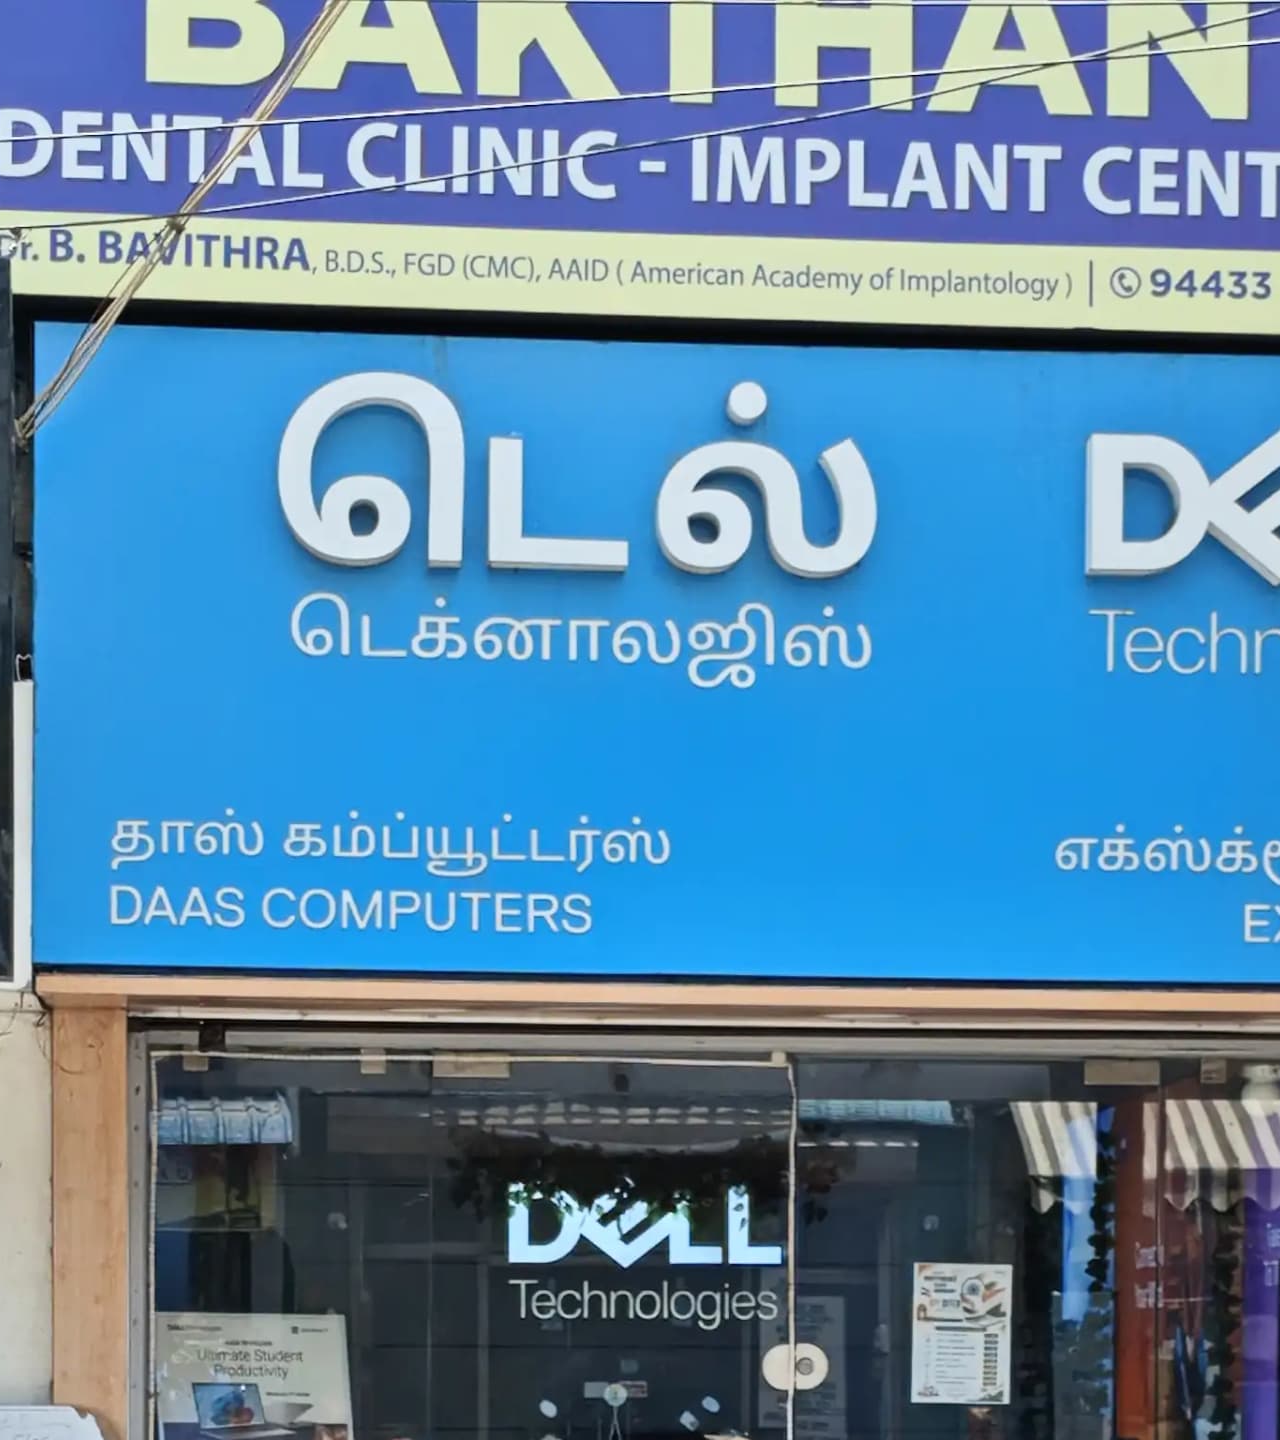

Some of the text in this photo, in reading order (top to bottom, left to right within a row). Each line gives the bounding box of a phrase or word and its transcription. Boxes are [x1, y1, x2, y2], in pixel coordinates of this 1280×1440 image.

[146, 0, 1249, 120] BAKTHAN
[347, 122, 618, 201] CLINIC
[690, 135, 1062, 213] IMPLANT
[49, 229, 86, 264] B.
[405, 251, 455, 278] FGD
[462, 252, 543, 282] (CMC),
[548, 257, 609, 280] AAID
[631, 262, 744, 288] American
[752, 265, 863, 295] Academy
[869, 267, 894, 292] of
[900, 268, 1060, 300] Implantology
[1150, 270, 1272, 302] 94433
[276, 370, 879, 580] டெல்
[290, 592, 874, 690] டெக்னாலஜிஸ்
[109, 808, 672, 878] தாஸ் கம்ப்யூட்டர்ஸ்
[109, 885, 594, 934] DAAS COMPUTERS
[507, 1182, 784, 1269] DELL
[509, 1278, 778, 1331] Technologies
